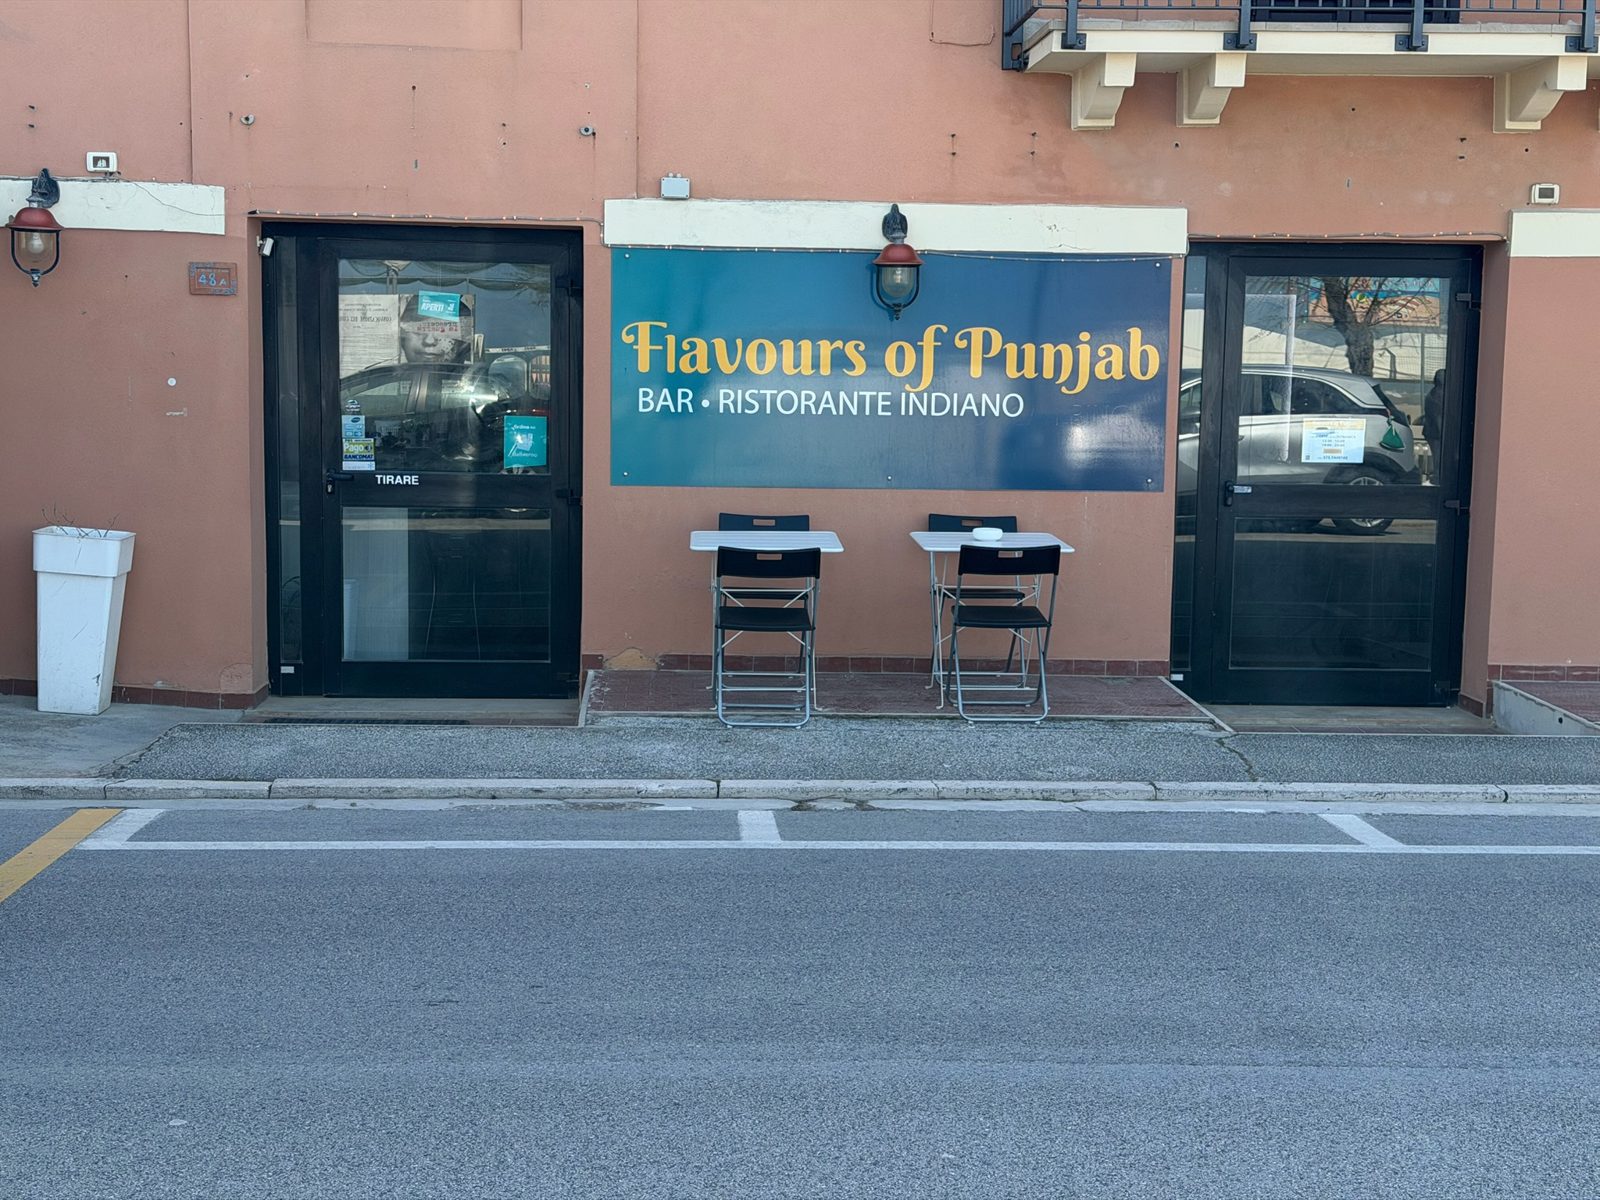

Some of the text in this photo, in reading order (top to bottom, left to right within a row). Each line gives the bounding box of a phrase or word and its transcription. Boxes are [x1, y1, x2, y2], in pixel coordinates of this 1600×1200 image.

[621, 321, 1161, 395] Flavours of Punjab
[639, 387, 693, 412] BAR
[719, 388, 892, 416] RISTORANTE
[900, 391, 1024, 418] INDIANO
[375, 474, 419, 486] TIRARE
